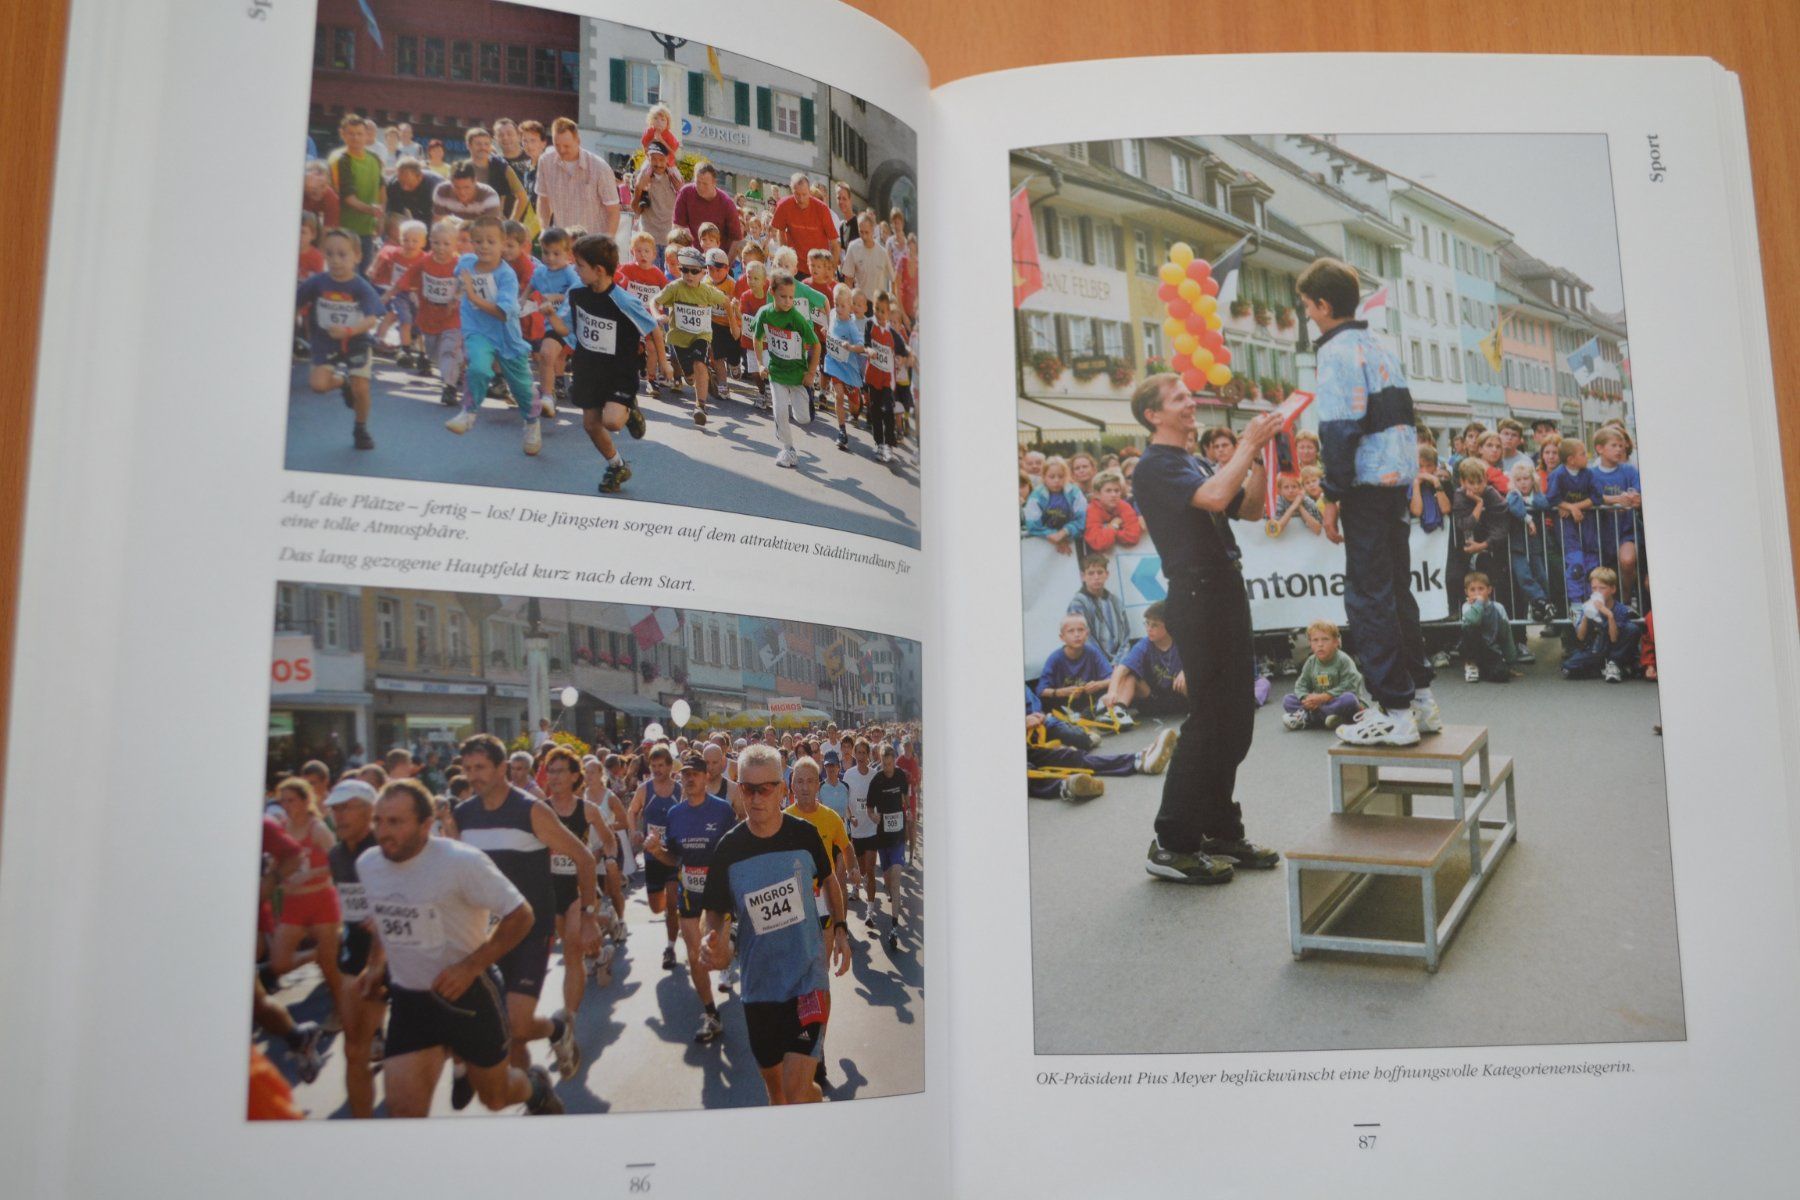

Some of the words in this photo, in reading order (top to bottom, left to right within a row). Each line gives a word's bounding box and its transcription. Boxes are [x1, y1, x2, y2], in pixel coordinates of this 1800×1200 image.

[1647, 134, 1666, 183] Sport
[629, 282, 656, 294] MIGROS
[637, 292, 649, 303] 78
[578, 310, 613, 331] MIGROS
[676, 307, 705, 317] MIGROS
[681, 315, 702, 327] 349
[583, 326, 600, 342] 86
[771, 337, 788, 352] 813
[280, 515, 318, 530] eine
[323, 516, 359, 532] tolle
[363, 519, 470, 541] Atmosphäre.
[283, 490, 319, 507] Auf
[319, 492, 347, 508] die
[352, 494, 404, 512] Plätze
[420, 500, 467, 520] fertig
[487, 505, 514, 521] los!
[519, 508, 547, 523] Die
[548, 511, 618, 530] Jüngsten
[623, 520, 673, 537] sorgen
[678, 526, 704, 542] auf
[706, 527, 736, 543] dem
[740, 533, 809, 554] attraktiven
[813, 543, 896, 571] Städtlirundkurs
[896, 560, 911, 574] für
[279, 546, 313, 564] Das
[318, 549, 358, 569] lang
[361, 554, 441, 574] gezogene
[445, 558, 528, 579] Hauptfeld
[532, 563, 571, 580] kurz
[576, 570, 615, 585] nach
[620, 571, 653, 588] dem
[657, 574, 696, 592] Start.
[687, 876, 705, 886] 986
[749, 882, 794, 908] MIGROS
[374, 903, 420, 919] MIGROS
[760, 898, 792, 921] 344
[382, 918, 413, 936] 361
[1036, 1071, 1132, 1085] OK-Präsident
[1137, 1071, 1168, 1084] Pius
[1172, 1071, 1216, 1087] Meyer
[1220, 1068, 1335, 1087] beglückwünscht
[1339, 1066, 1370, 1080] eine
[1373, 1063, 1478, 1083] hoffnungsvolle
[1482, 1060, 1635, 1078] Kategorienensiegerin.
[1358, 1135, 1377, 1150] 87
[629, 1174, 651, 1193] 86
